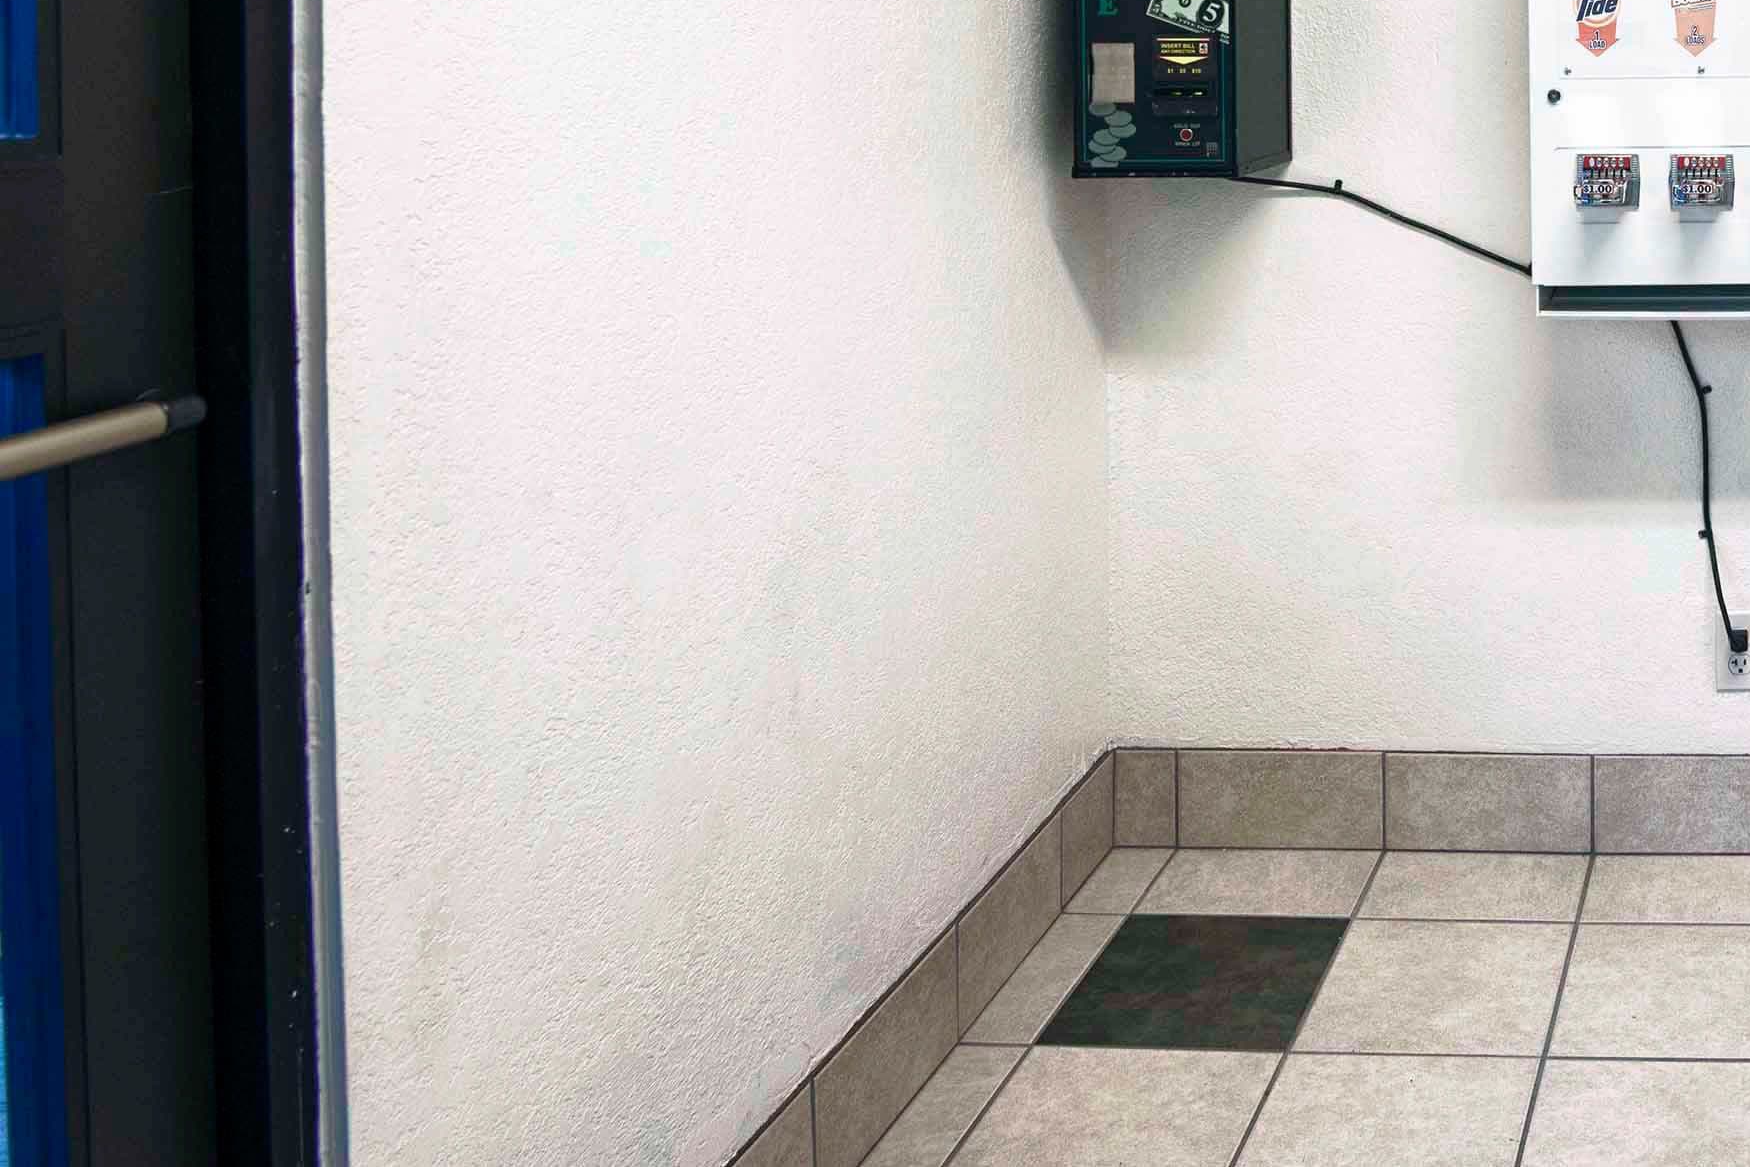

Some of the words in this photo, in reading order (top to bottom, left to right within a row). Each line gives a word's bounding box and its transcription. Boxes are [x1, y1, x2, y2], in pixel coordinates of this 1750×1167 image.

[1202, 2, 1220, 23] 5
[1593, 30, 1600, 41] 1
[1691, 25, 1699, 36] 2
[1589, 41, 1606, 49] LOAD
[1687, 36, 1705, 45] LOADS
[1583, 184, 1612, 194] $1.00
[1682, 184, 1712, 194] $1.00
